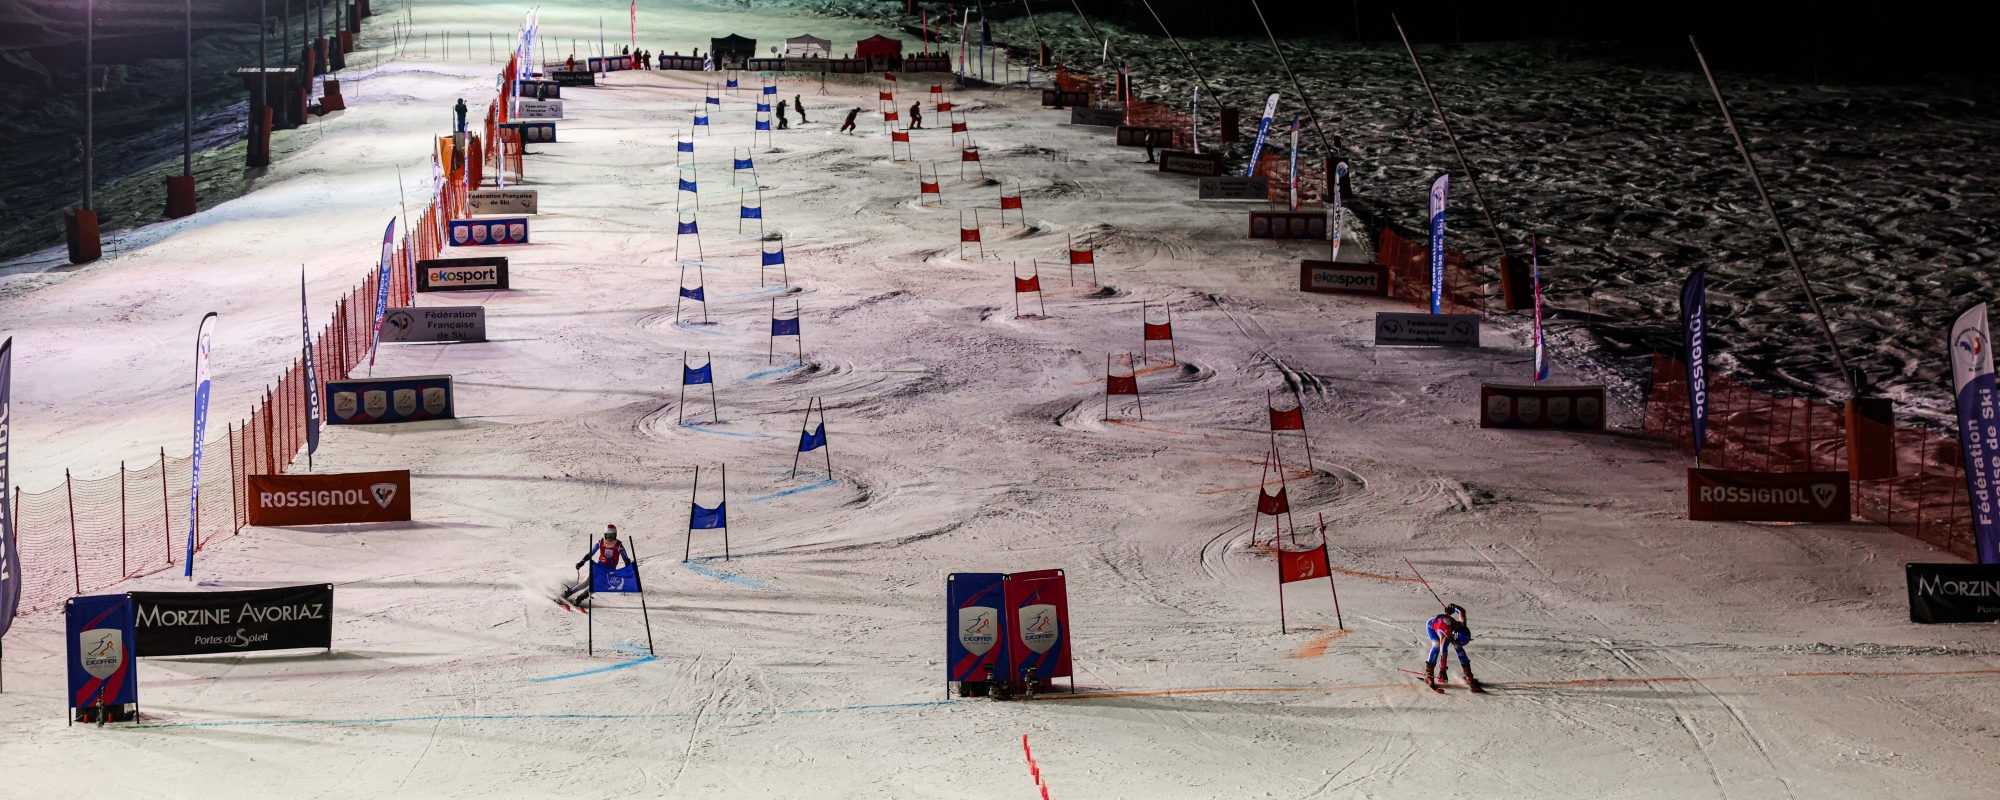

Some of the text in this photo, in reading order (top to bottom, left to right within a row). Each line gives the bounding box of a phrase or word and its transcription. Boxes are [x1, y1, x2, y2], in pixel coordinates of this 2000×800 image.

[430, 268, 495, 284] ekosport
[1314, 272, 1376, 287] ekosport
[427, 321, 475, 330] Française
[437, 331, 467, 339] de Ski
[1979, 388, 1995, 419] Ski
[1986, 425, 1999, 450] de
[1968, 419, 1992, 525] Fédération
[260, 489, 369, 508] ROSSIGNOL
[1700, 486, 1809, 504] ROSSIGNOL
[135, 602, 324, 628] MORZINE AVORIAZ
[194, 628, 269, 647] Portes du Soleil
[1025, 633, 1054, 641] EXCOFFIER
